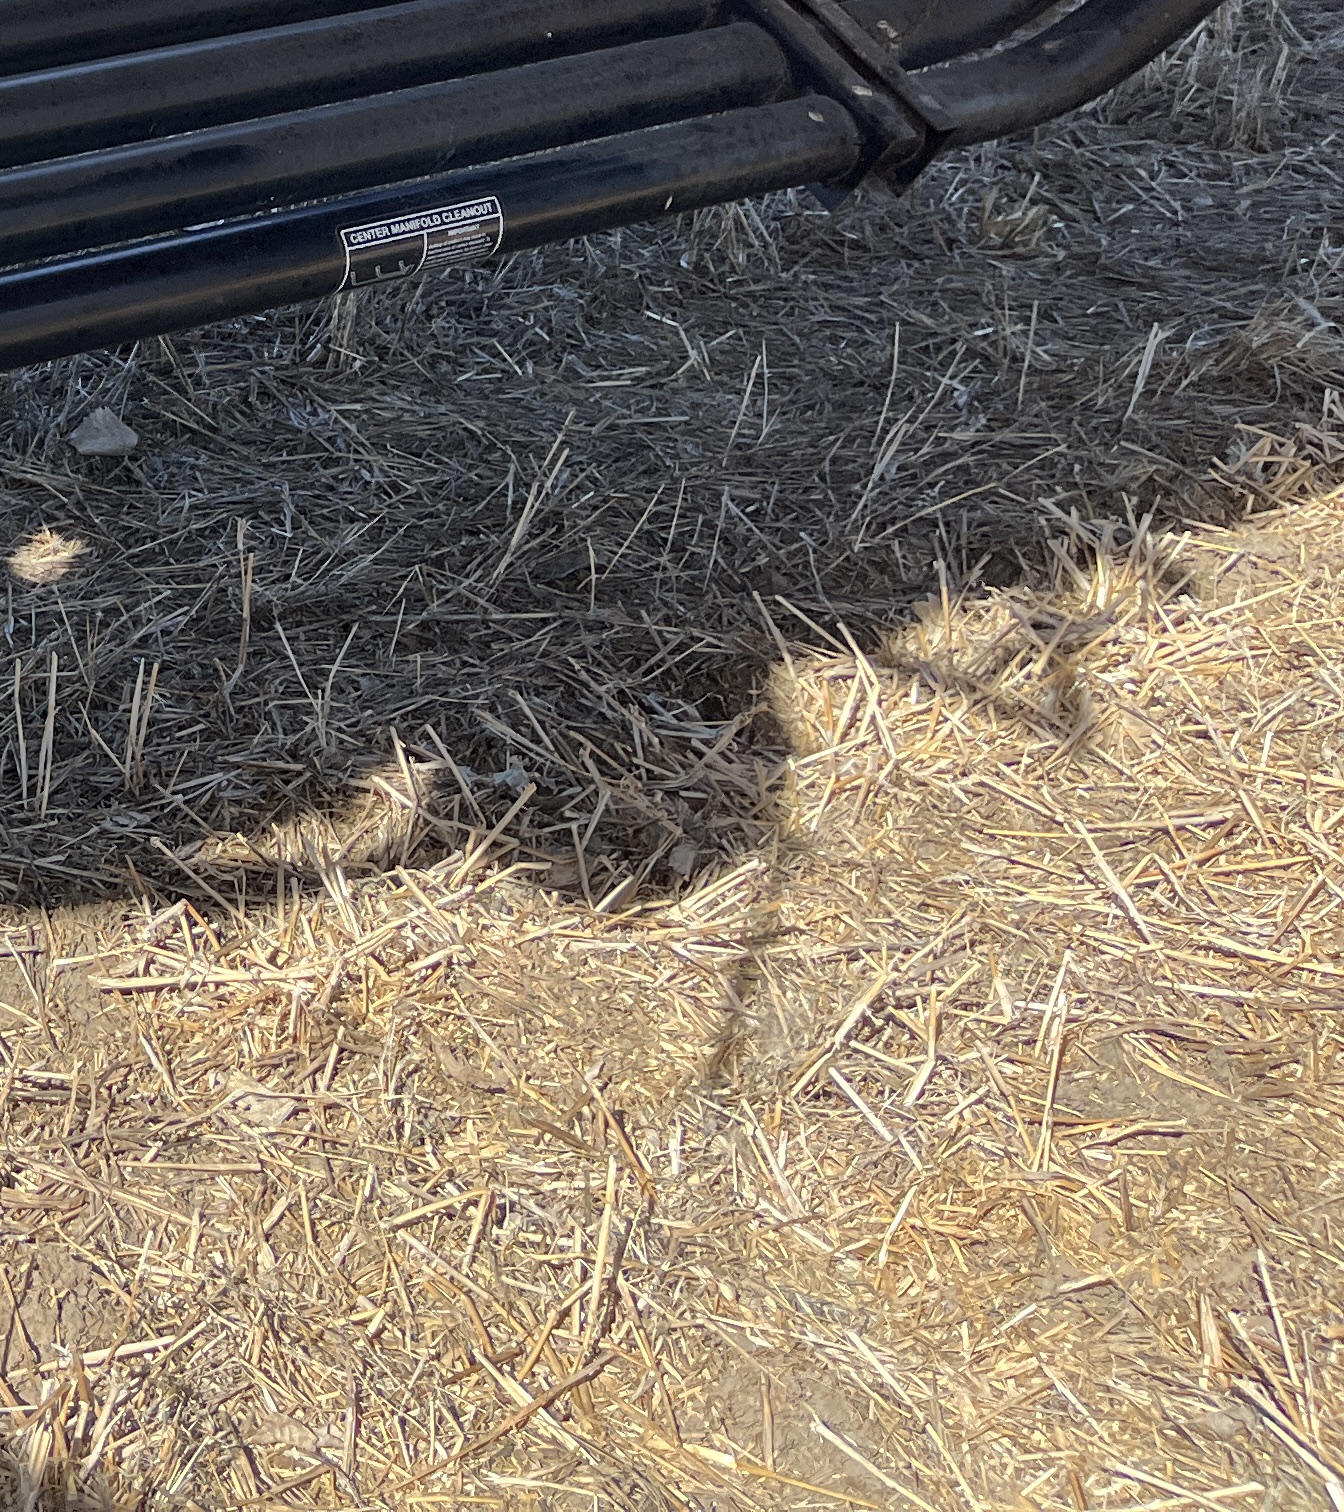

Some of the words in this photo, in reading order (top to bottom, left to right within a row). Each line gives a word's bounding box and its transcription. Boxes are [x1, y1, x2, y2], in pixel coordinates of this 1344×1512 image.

[349, 227, 390, 244] CENTER
[391, 214, 441, 235] MANIFOLD
[442, 202, 493, 223] CLEANOUT
